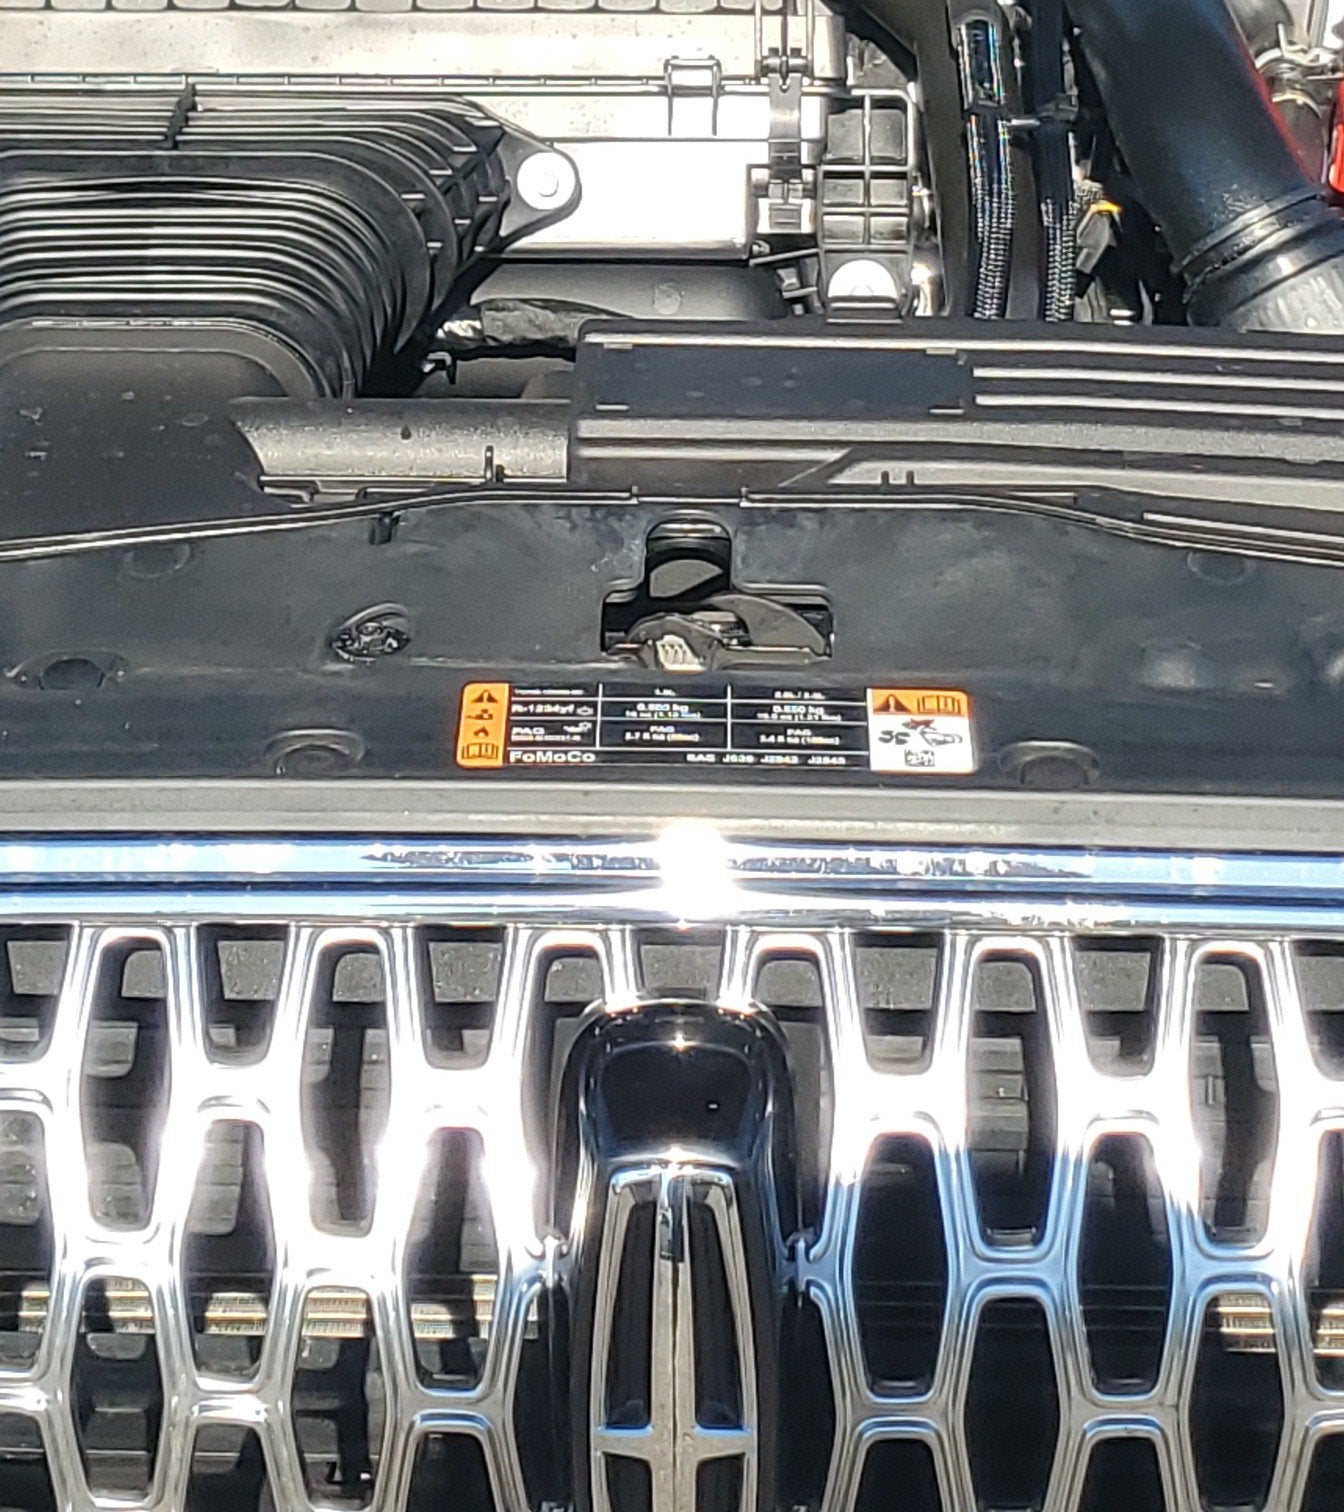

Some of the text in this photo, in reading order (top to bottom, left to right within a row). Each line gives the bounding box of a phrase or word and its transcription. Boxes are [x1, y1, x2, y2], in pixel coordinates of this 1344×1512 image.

[511, 703, 575, 715] R-1234yf
[672, 703, 690, 713] kg
[808, 705, 825, 715] kg
[511, 726, 545, 735] PAG
[509, 750, 596, 763] FoMoCo
